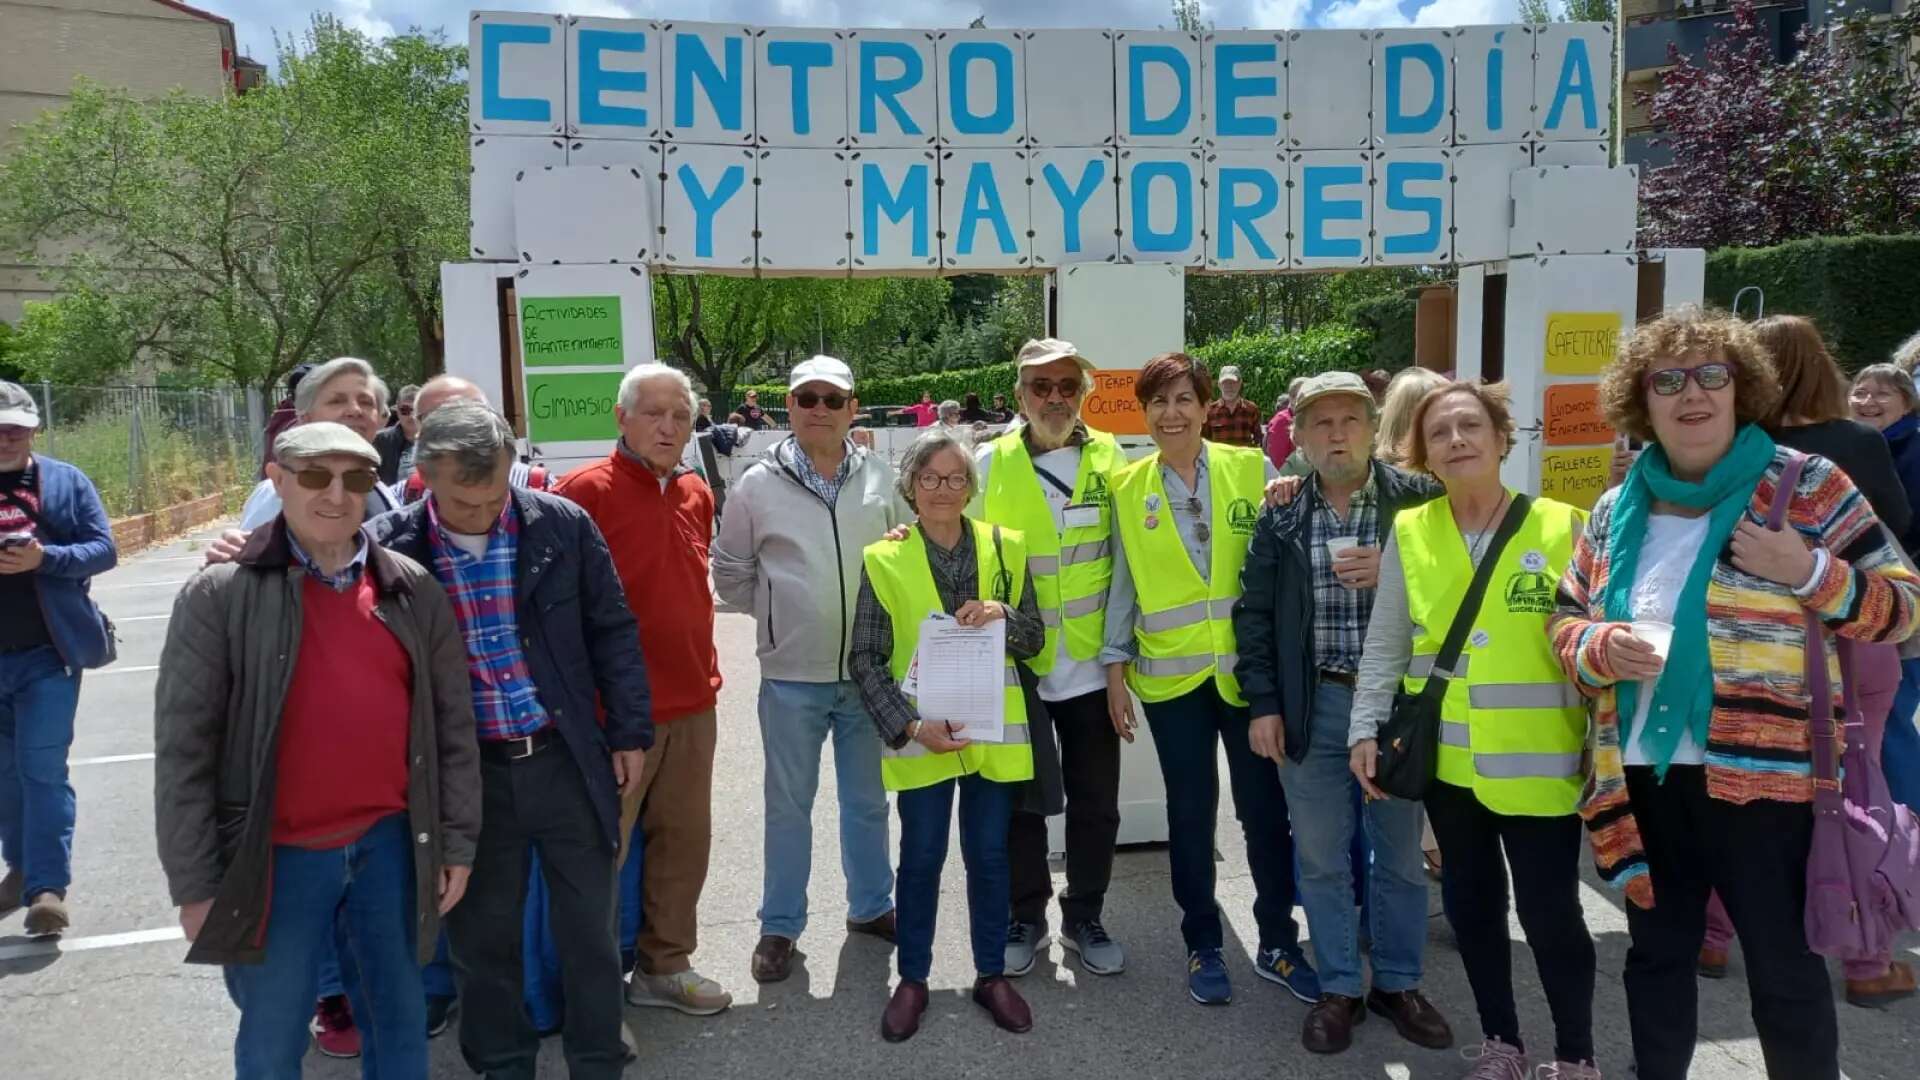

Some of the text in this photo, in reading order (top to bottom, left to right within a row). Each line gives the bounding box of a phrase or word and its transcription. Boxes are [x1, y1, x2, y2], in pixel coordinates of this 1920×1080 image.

[482, 23, 1597, 136] CENTRO DE DÍA
[678, 160, 1444, 259] Y MAYORES
[523, 304, 608, 322] ACTIVIDADES
[525, 326, 537, 340] DE
[1094, 373, 1136, 390] TERAP
[532, 384, 613, 419] GIMNASIO
[1088, 395, 1136, 414] OCUPAC
[1544, 456, 1601, 472] TALLERES
[1542, 475, 1609, 491] DE MEMORI
